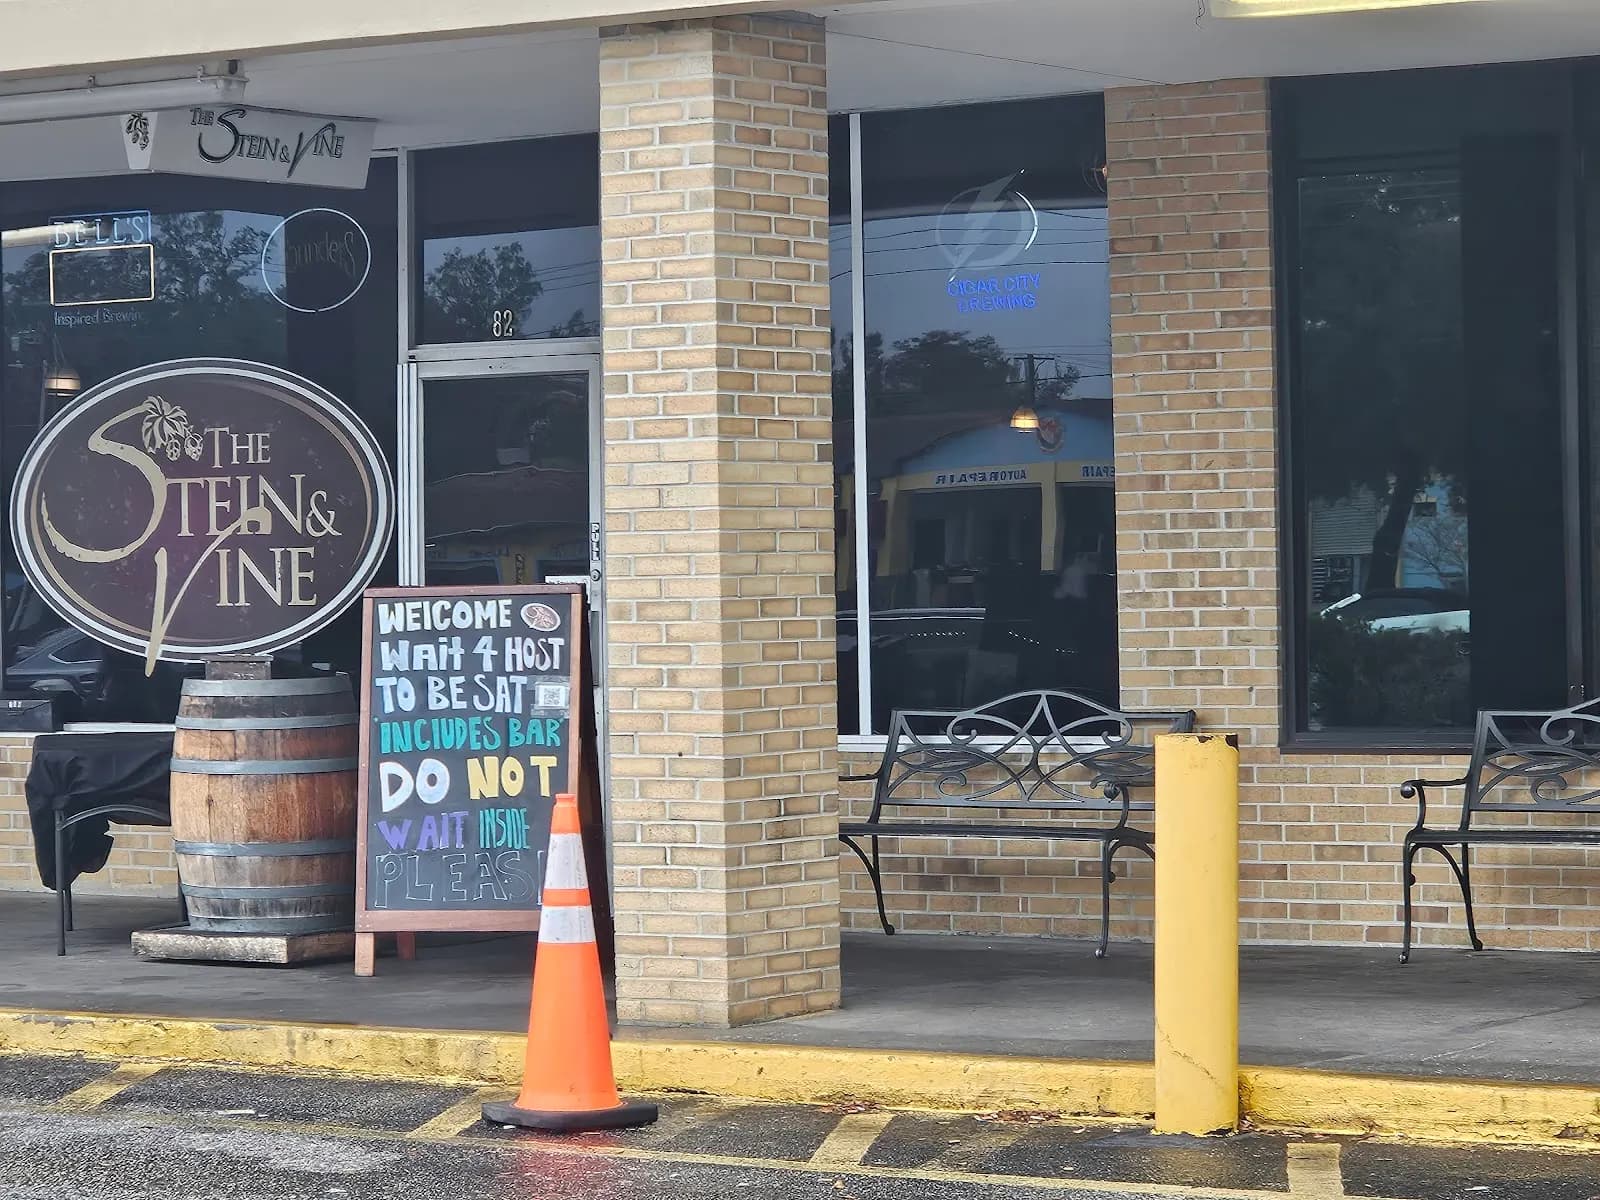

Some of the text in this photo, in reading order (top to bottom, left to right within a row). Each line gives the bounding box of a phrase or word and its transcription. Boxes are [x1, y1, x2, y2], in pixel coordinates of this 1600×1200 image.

[190, 108, 214, 126] THE
[199, 109, 345, 178] STEIN & VINE
[948, 272, 1040, 296] CIGAR CITY
[55, 308, 142, 327] Inspired Brewin
[493, 310, 513, 337] 82
[203, 427, 271, 468] THE
[41, 400, 342, 563] STEIN &
[145, 506, 317, 677] VINE
[472, 636, 498, 672] 4
[505, 637, 565, 672] HOST
[375, 674, 528, 713] TO BE SAT
[509, 718, 561, 747] BAR
[379, 756, 557, 812] DO NOT
[376, 808, 531, 850] WAIT INSIDE
[375, 850, 544, 908] PLEAS
